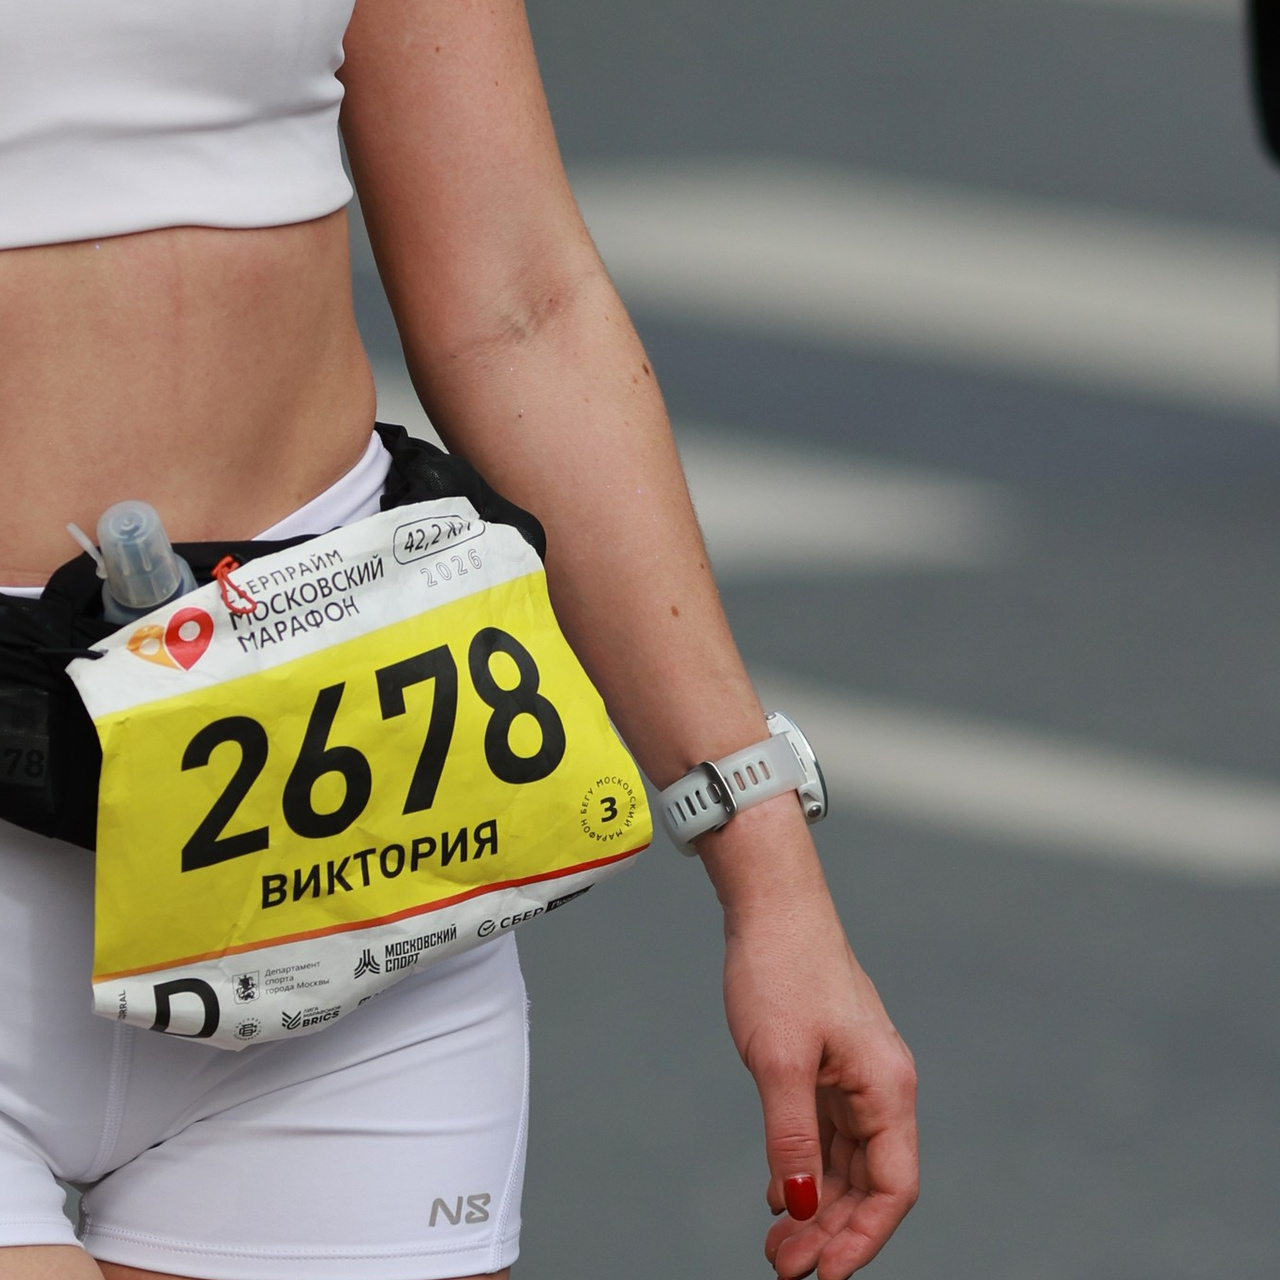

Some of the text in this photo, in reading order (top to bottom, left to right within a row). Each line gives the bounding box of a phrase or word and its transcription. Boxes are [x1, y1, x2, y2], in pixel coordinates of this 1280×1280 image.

[404, 523, 442, 553] 42,2
[420, 548, 482, 587] 2026
[229, 554, 384, 631] МОСКОВСКИЙ
[236, 595, 360, 653] МАРАФОН
[181, 626, 566, 873] 2678
[261, 819, 498, 910] ВИКТОРИЯ
[500, 906, 544, 929] СБЕР
[385, 923, 457, 959] МОСКОВСКИЙ
[264, 961, 321, 978] Департамент
[385, 952, 420, 973] СПОРТ
[264, 975, 294, 986] спорта
[266, 978, 330, 996] города Москвы
[148, 978, 220, 1038] D
[302, 1010, 340, 1028] BRICS
